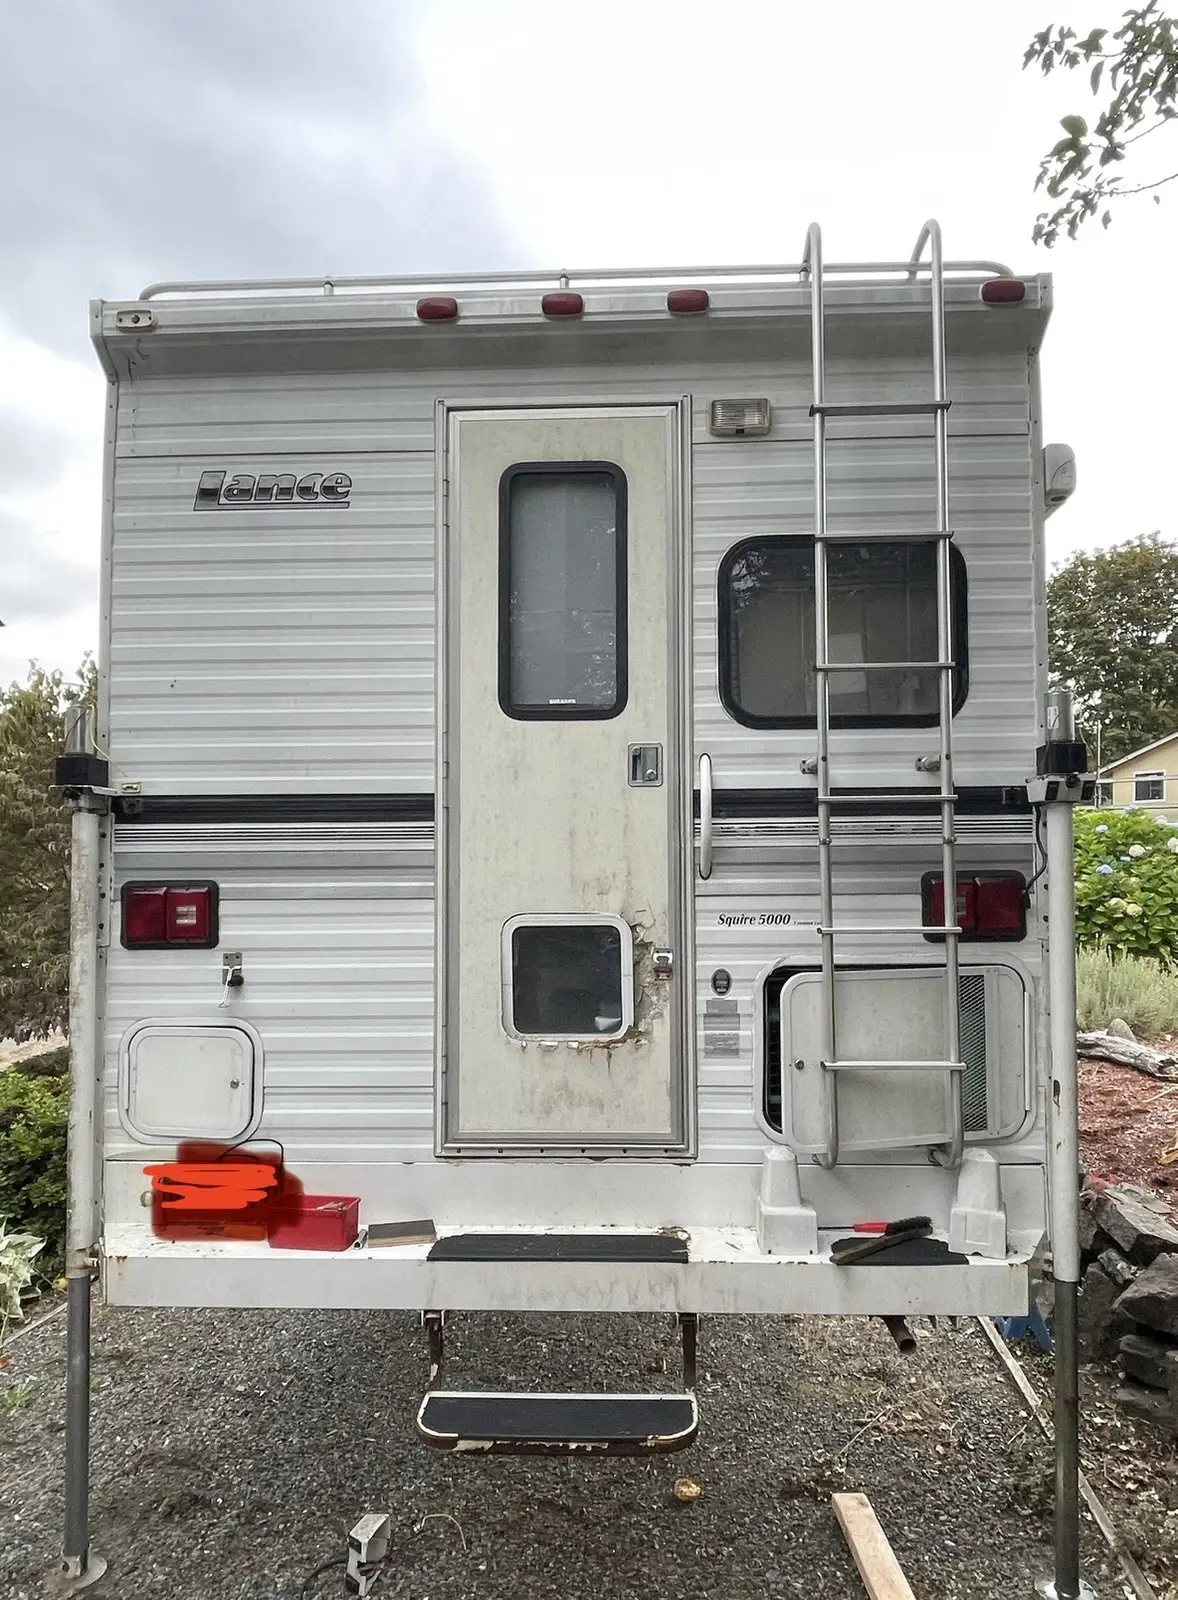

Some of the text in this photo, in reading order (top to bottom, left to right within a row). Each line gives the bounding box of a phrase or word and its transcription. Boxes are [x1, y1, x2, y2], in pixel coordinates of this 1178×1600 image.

[193, 470, 352, 511] Lance
[718, 913, 791, 927] Squire 5000
